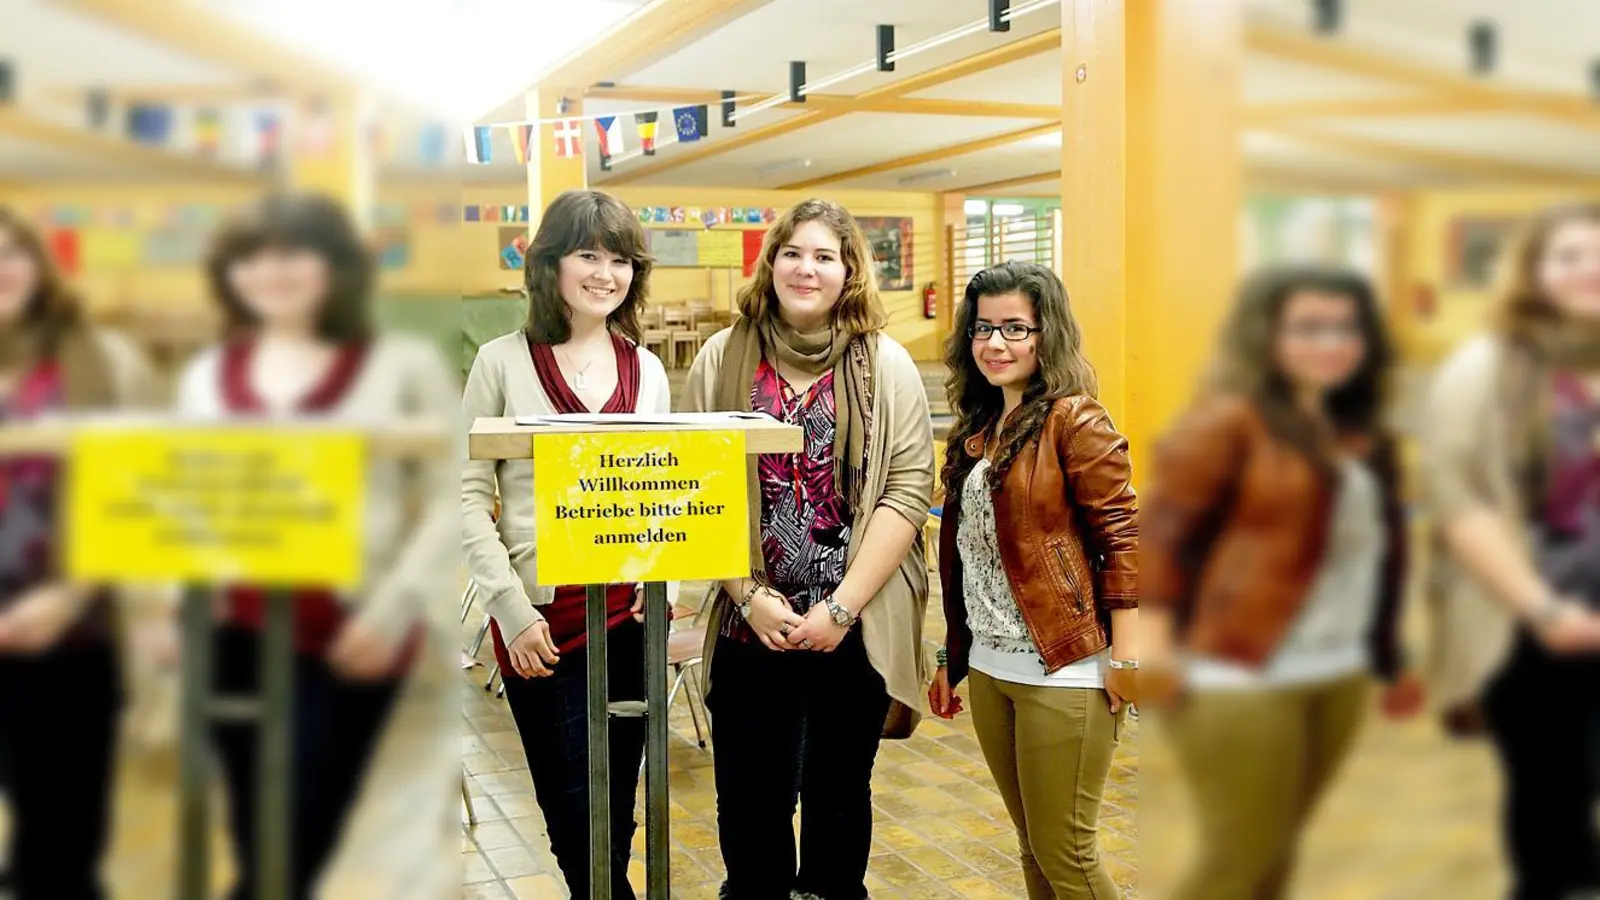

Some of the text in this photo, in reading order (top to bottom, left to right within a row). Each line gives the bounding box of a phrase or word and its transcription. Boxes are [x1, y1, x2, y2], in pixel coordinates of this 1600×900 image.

[600, 452, 679, 468] Herzlich
[579, 476, 700, 492] Willkommen
[555, 501, 725, 519] Betriebe bitte hier
[594, 528, 687, 545] anmelden
